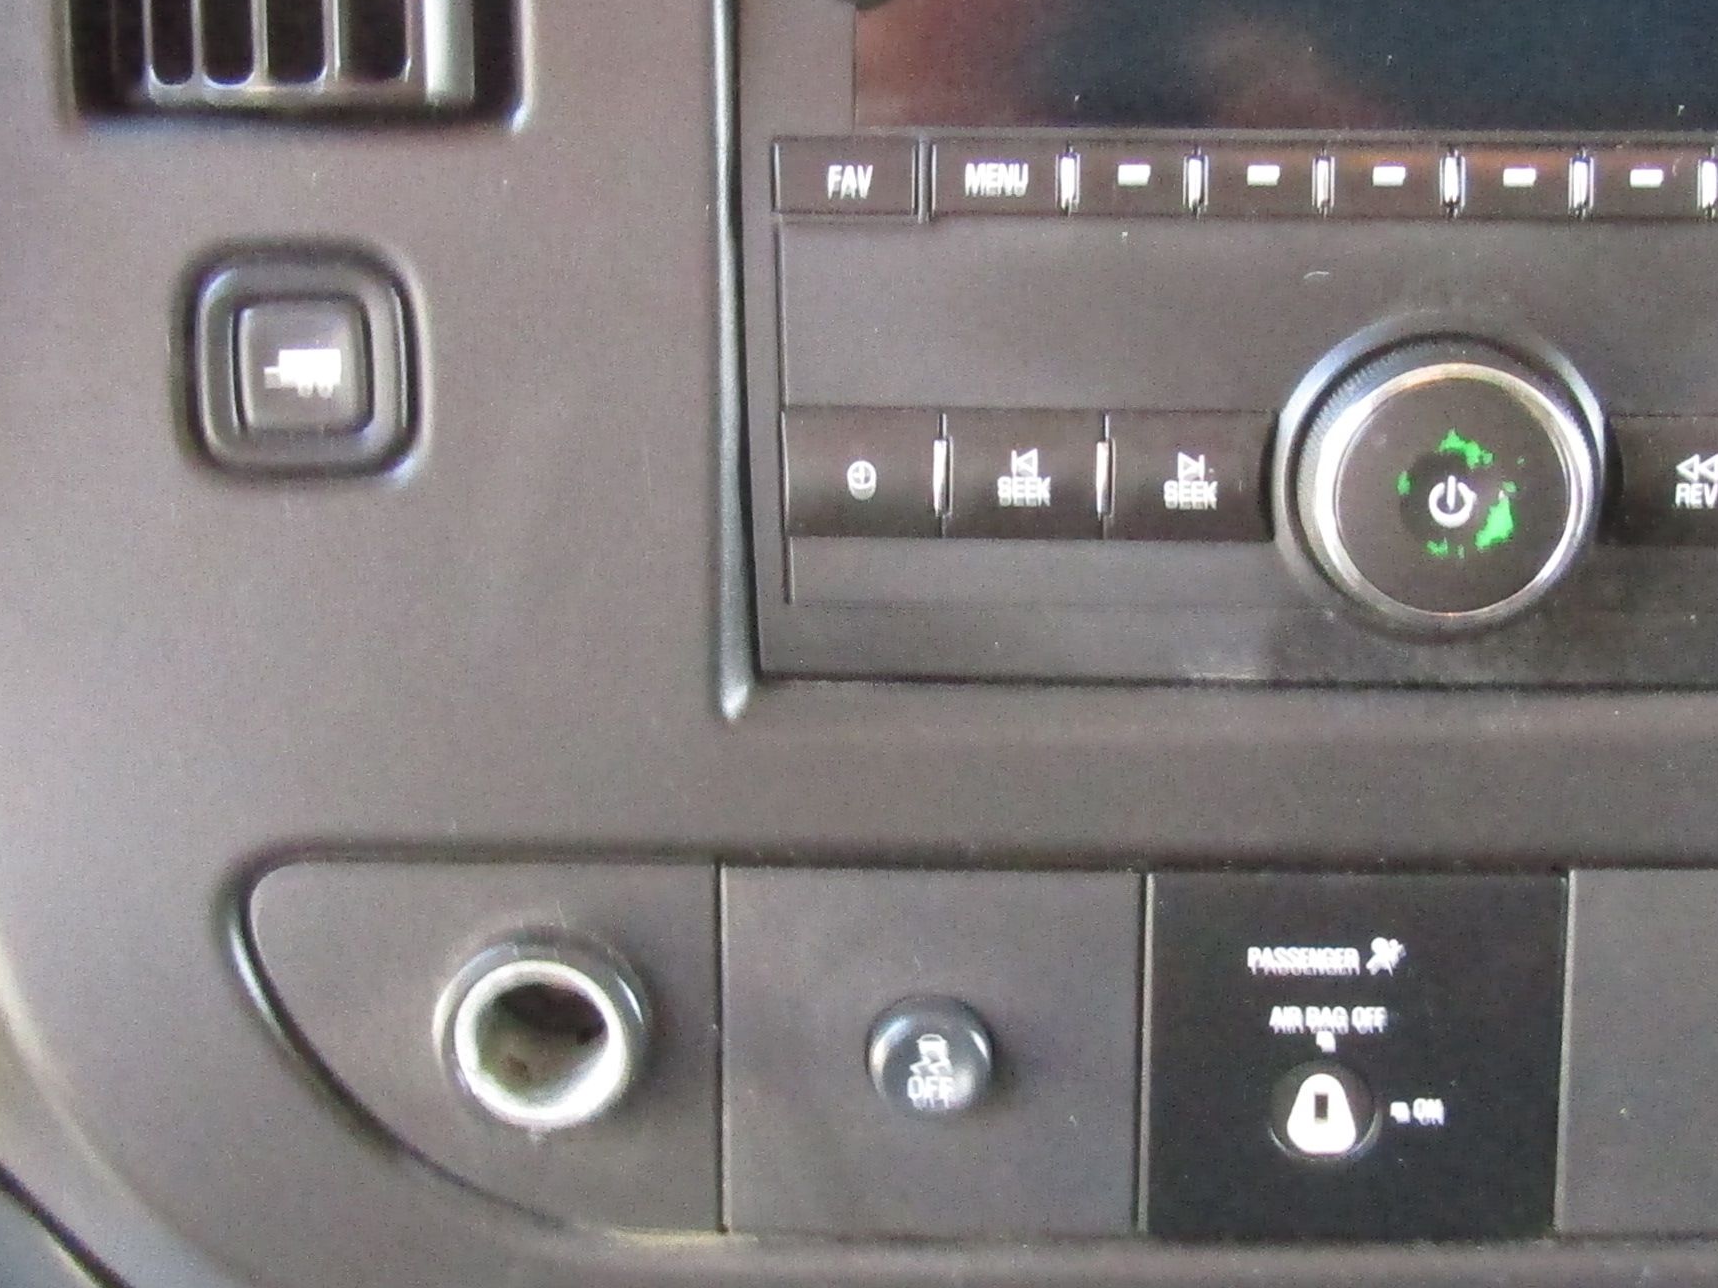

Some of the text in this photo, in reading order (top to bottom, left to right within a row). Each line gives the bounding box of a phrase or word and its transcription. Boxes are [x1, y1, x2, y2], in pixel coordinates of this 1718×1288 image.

[827, 165, 873, 198] FAV
[965, 163, 1028, 197] MENU
[997, 476, 1050, 506] SEEK
[1164, 480, 1218, 509] SEEK
[1676, 483, 1718, 509] REV
[1248, 947, 1359, 975] PASSENGER
[1269, 1006, 1387, 1033] AIR BAG OFF
[907, 1076, 954, 1109] OFF
